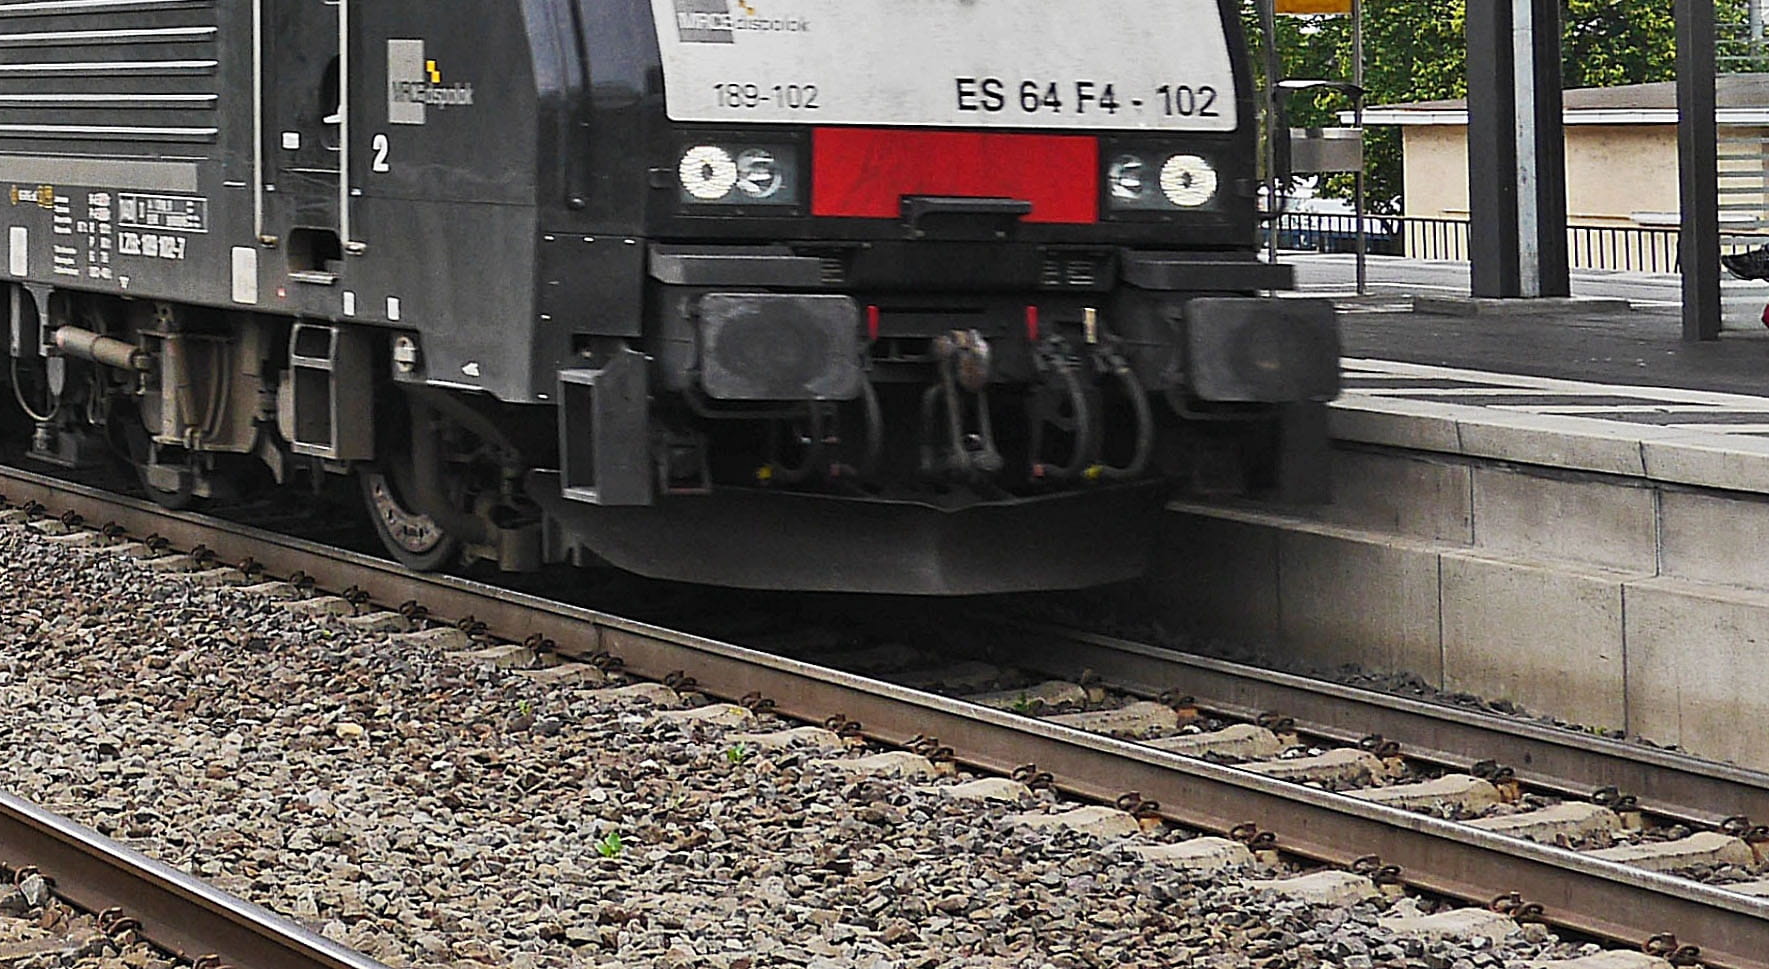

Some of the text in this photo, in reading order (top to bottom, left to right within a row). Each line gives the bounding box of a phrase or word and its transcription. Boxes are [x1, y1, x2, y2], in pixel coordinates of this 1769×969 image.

[714, 83, 820, 109] 189-102
[955, 77, 1005, 113] ES
[1019, 80, 1063, 114] 64
[1075, 80, 1121, 115] F4
[1155, 84, 1220, 117] 102
[372, 134, 390, 172] 2
